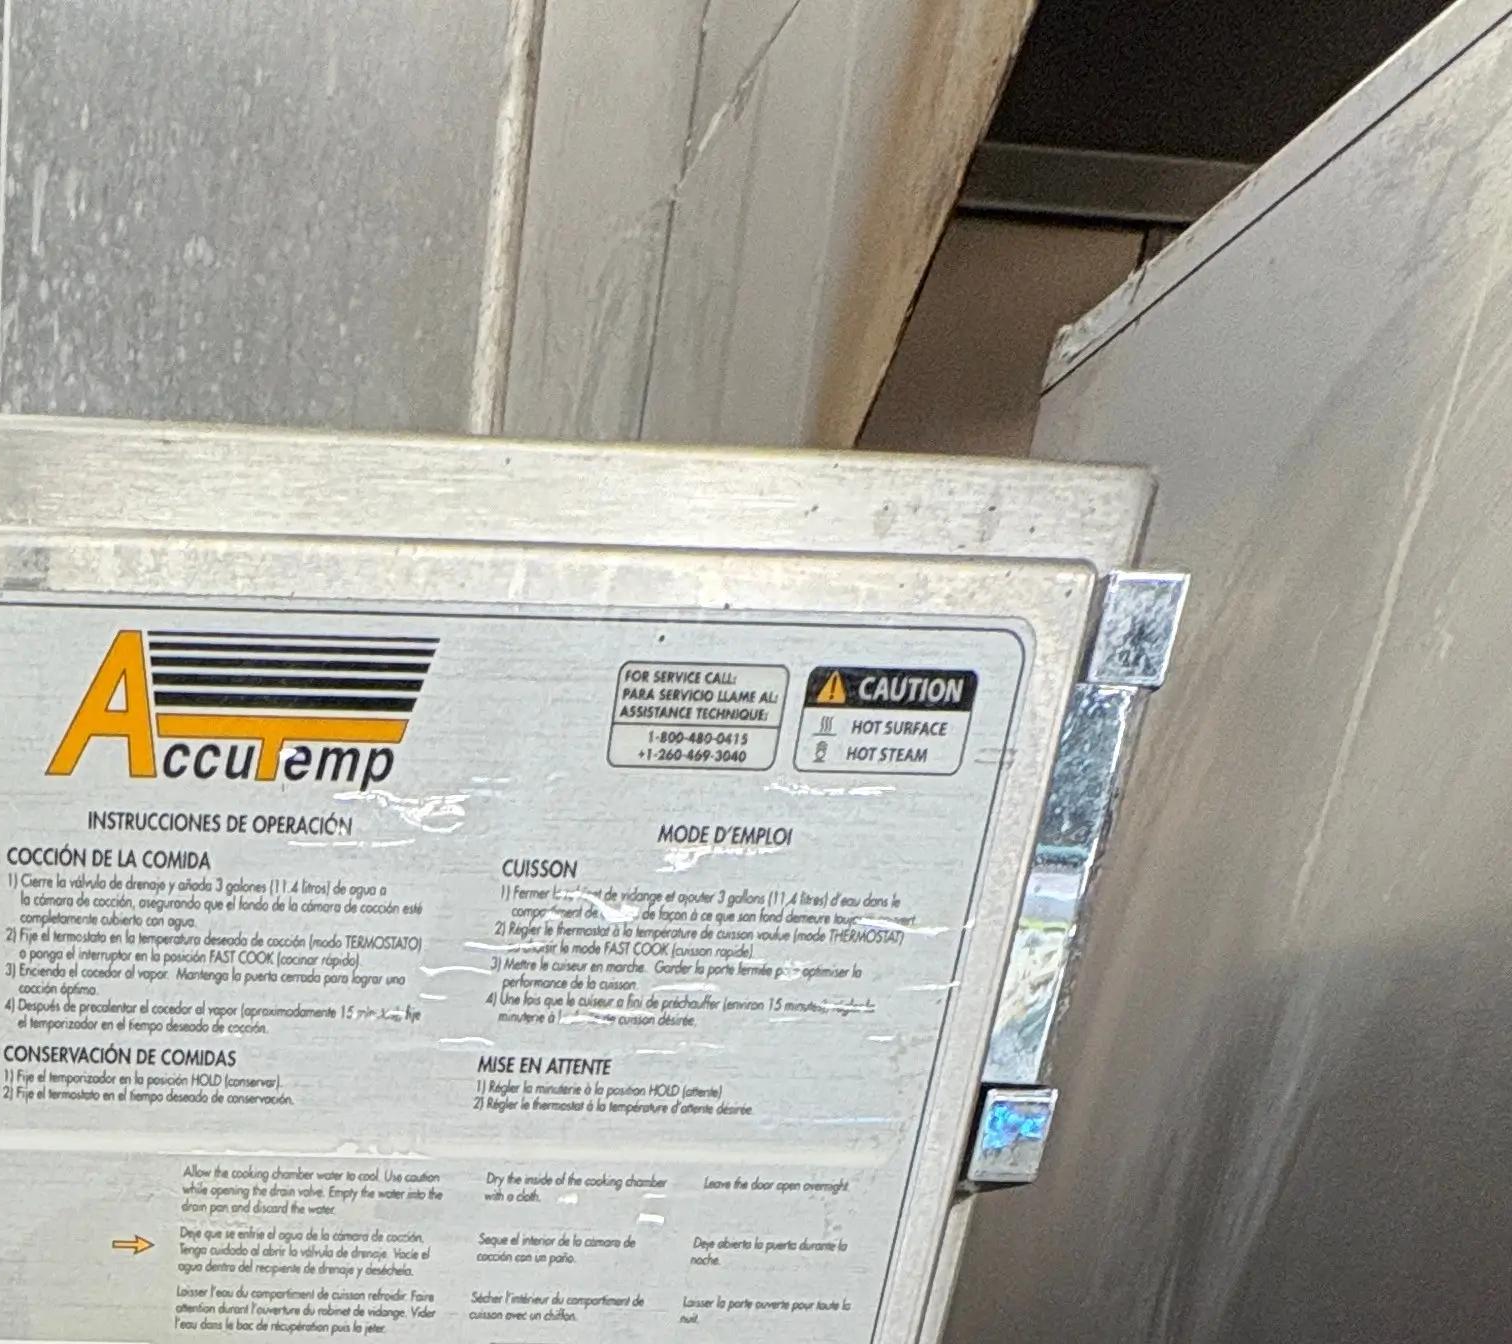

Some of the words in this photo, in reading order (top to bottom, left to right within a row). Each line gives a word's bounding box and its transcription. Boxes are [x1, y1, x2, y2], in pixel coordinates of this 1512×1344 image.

[625, 670, 649, 682] FOR
[654, 671, 701, 684] SERVICE
[704, 672, 736, 685] CALL:
[622, 688, 654, 700] PARA
[659, 688, 714, 702] SERVICIO
[717, 691, 756, 703] LLAME
[759, 692, 778, 703] AL:
[858, 679, 962, 703] CAUTION
[45, 630, 408, 791] AccuTemp
[620, 706, 692, 719] ASSISTANCE
[697, 707, 767, 721] TECHNIQUE:
[852, 720, 882, 734] HOT
[884, 721, 948, 736] SURFACE
[846, 747, 877, 761] HOT
[879, 747, 928, 762] STEAM
[88, 811, 221, 832] INSTRUCCIONES
[227, 815, 247, 833] DE
[252, 812, 352, 835] OPERACIÓN
[657, 825, 709, 843] MODE
[714, 826, 793, 846] D'EMPLOI
[7, 844, 86, 867] COCCIÓN
[92, 849, 112, 867] DE
[118, 849, 137, 868] LA
[142, 850, 211, 870] COMIDA
[502, 859, 577, 878] CUISSON
[4, 1043, 131, 1064] CONSERVACIÓN
[136, 1049, 156, 1065] DE
[161, 1049, 236, 1067] COMIDAS
[477, 1056, 515, 1073] MISE
[520, 1057, 542, 1074] EN
[546, 1058, 612, 1075] ATTENTE
